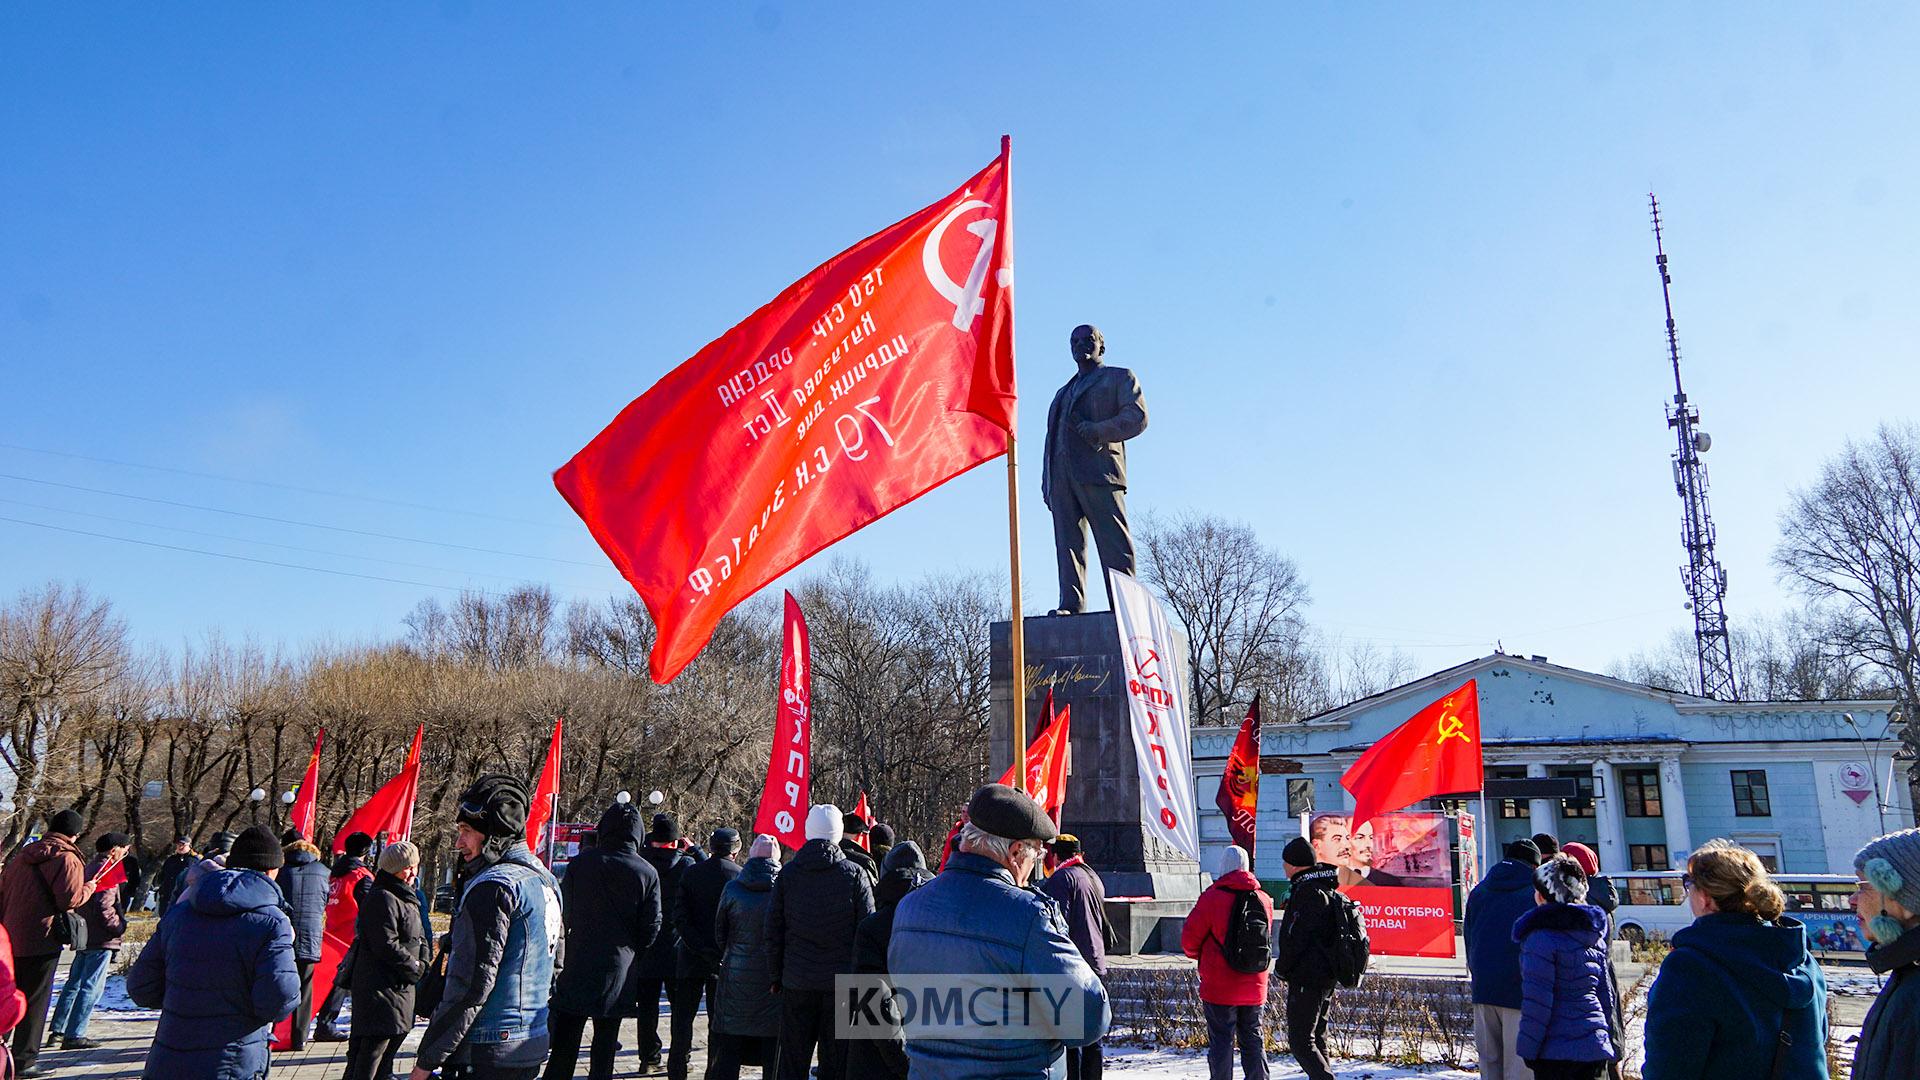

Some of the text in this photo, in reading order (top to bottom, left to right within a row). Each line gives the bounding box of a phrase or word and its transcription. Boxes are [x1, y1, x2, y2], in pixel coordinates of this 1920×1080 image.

[1357, 905, 1381, 916] ОМУ
[1384, 906, 1444, 918] ОКТЯБРЮ
[1364, 918, 1406, 929] СЛАВА!
